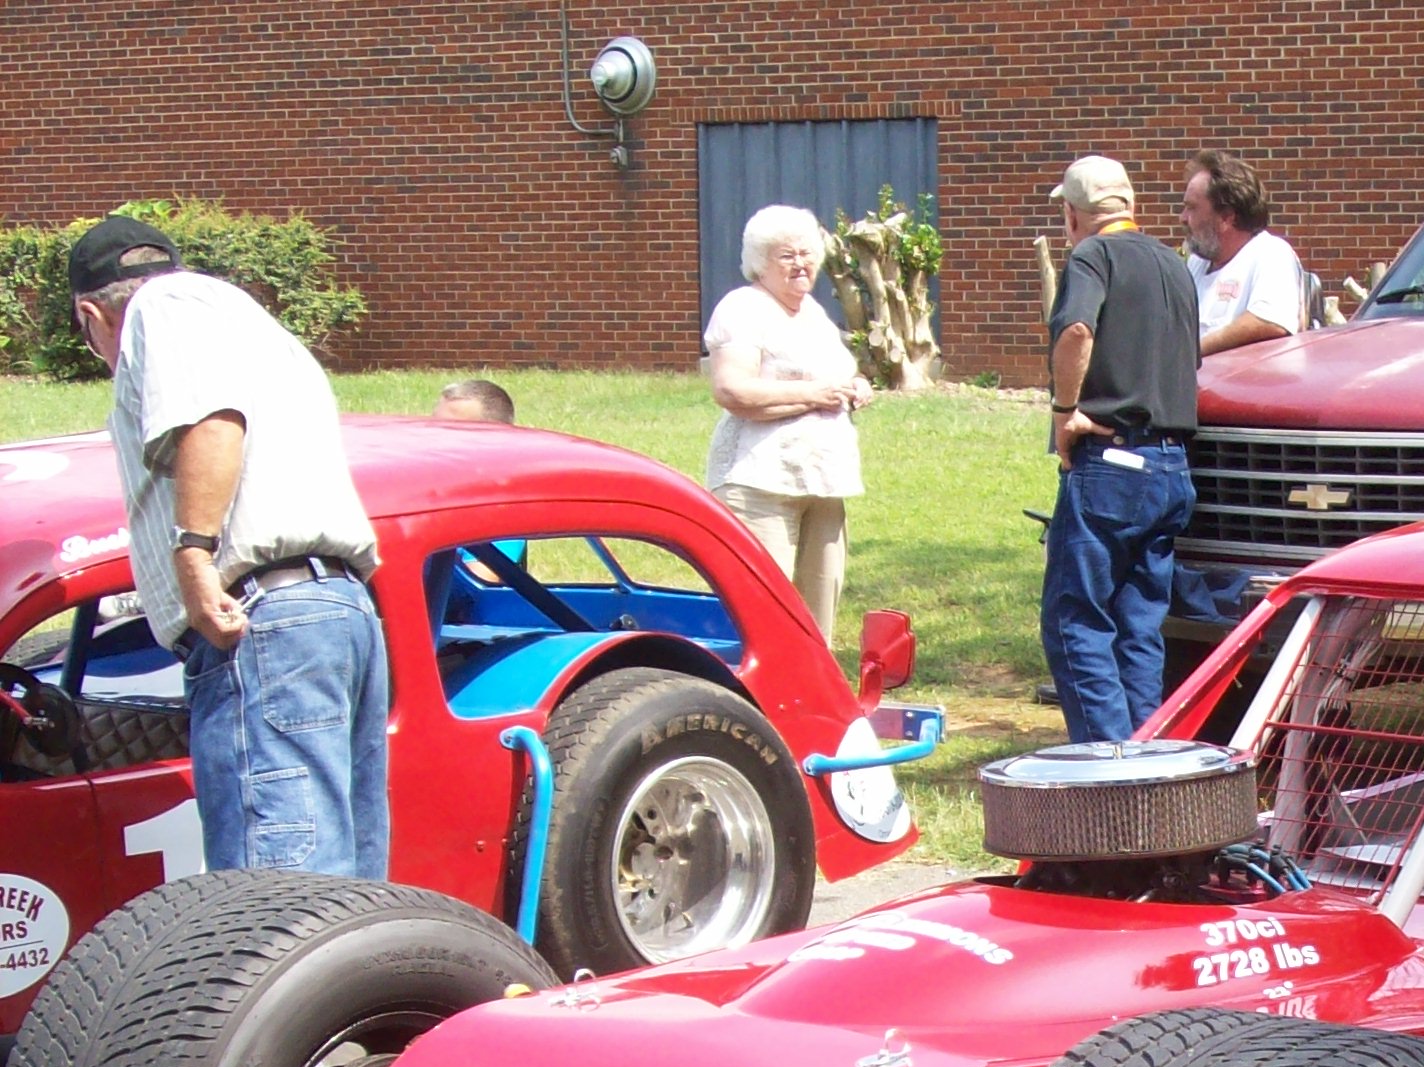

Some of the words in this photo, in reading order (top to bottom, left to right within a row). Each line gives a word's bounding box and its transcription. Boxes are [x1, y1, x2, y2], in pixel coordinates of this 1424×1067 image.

[640, 713, 778, 766] AMERICAN
[1200, 917, 1286, 947] 370ci
[1193, 947, 1270, 986] 2728
[1272, 943, 1320, 969] lbs
